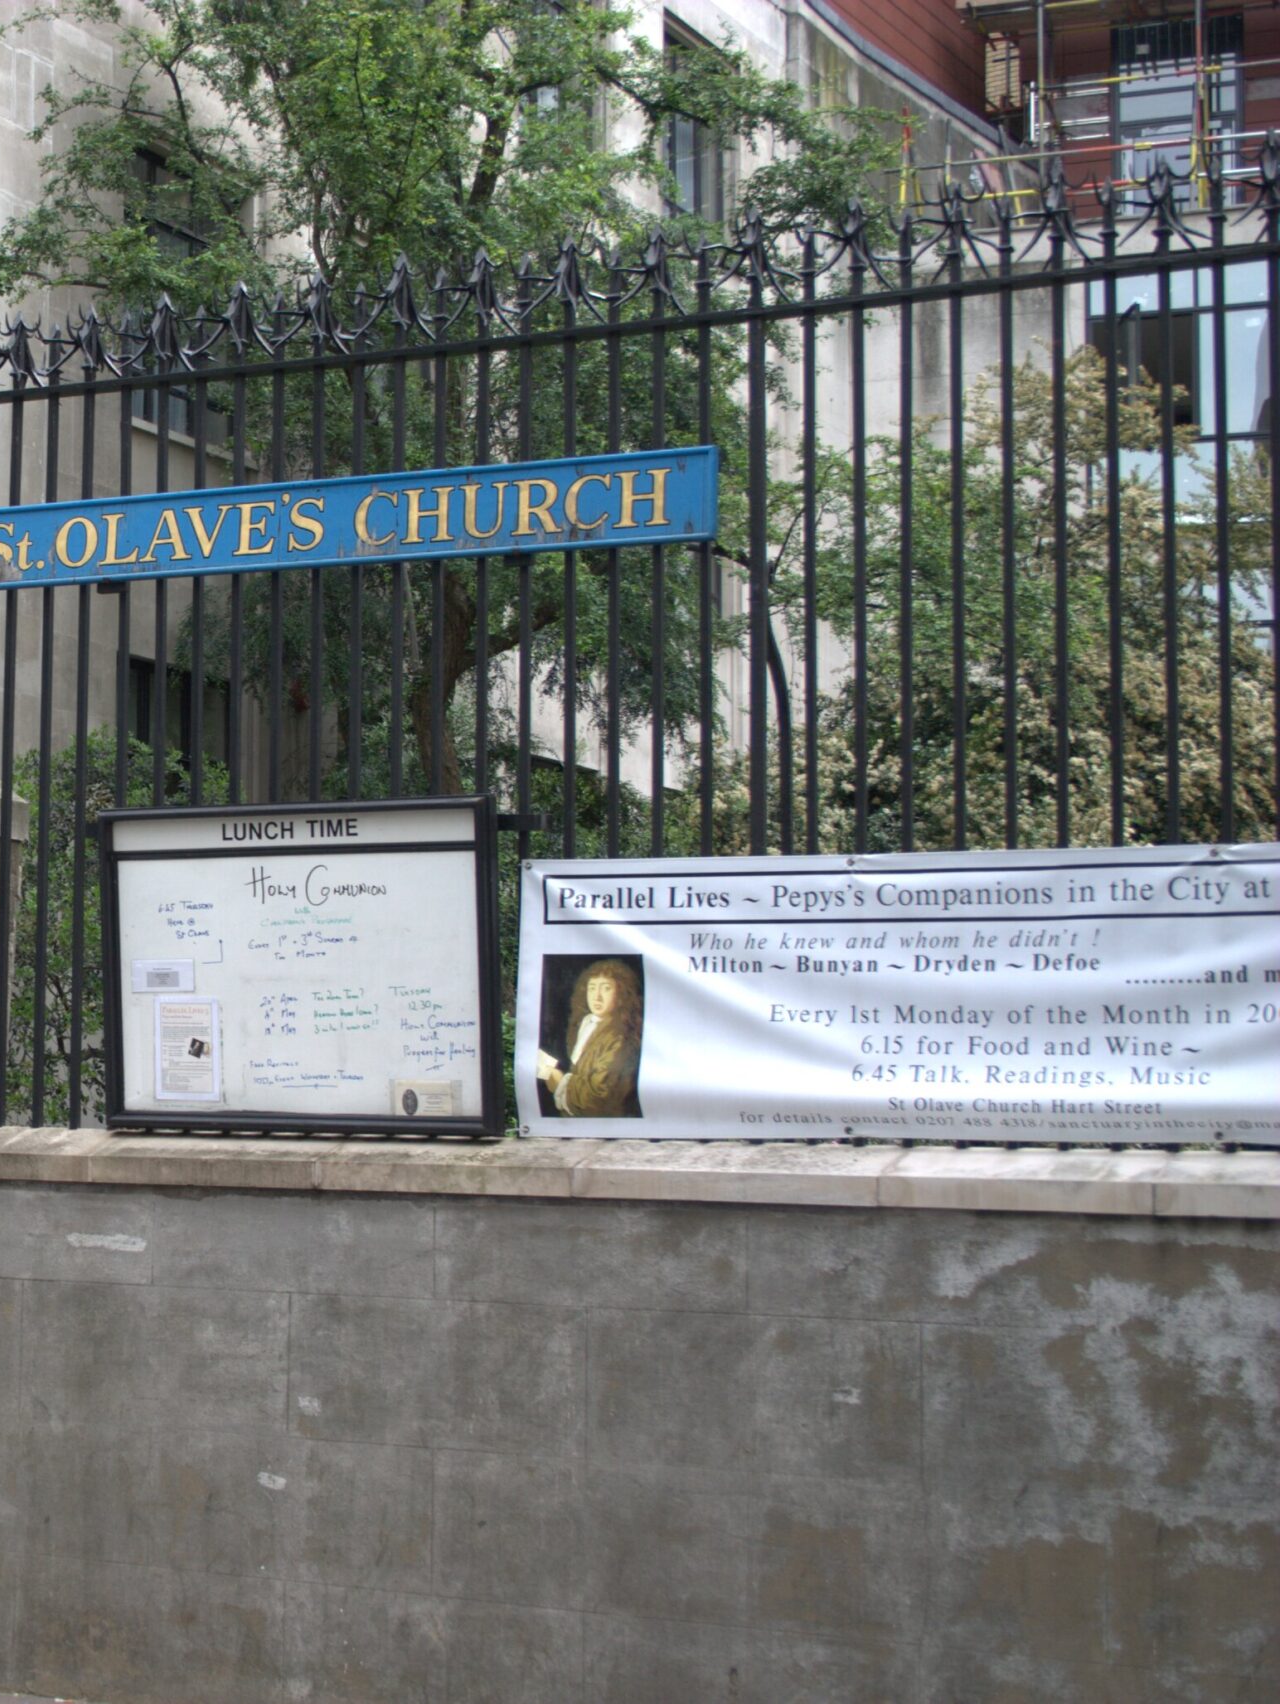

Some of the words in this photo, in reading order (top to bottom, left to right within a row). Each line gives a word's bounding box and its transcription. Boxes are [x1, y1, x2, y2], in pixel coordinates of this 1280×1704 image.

[54, 491, 325, 569] OLAVE'S
[354, 467, 672, 548] CHURCH
[222, 821, 294, 841] LUNCH
[306, 818, 359, 837] TIME
[558, 886, 655, 910] Parallel
[669, 886, 730, 908] Lives
[771, 884, 865, 912] Pepys's
[876, 881, 1053, 910] Companions
[1068, 879, 1095, 903] in
[1109, 878, 1154, 902] the
[1167, 876, 1230, 905] City
[1244, 877, 1271, 899] at
[689, 932, 734, 950] Who
[744, 932, 768, 950] he
[780, 932, 834, 950] knew
[846, 931, 888, 949] and
[900, 931, 959, 949] whom
[973, 930, 998, 948] he
[1009, 928, 1079, 949] didn't
[687, 956, 762, 973] Milton
[796, 955, 878, 976] Bunyan
[913, 954, 996, 975] Dryden
[1032, 953, 1101, 972] Defoe
[769, 1004, 837, 1027] Every
[850, 1004, 880, 1024] 1st
[894, 1004, 993, 1028] Monday
[1007, 1004, 1035, 1025] of
[1047, 1004, 1087, 1025] the
[1102, 1004, 1190, 1025] Month
[1205, 1003, 1231, 1024] in
[1247, 1003, 1280, 1024] 20
[861, 1036, 904, 1055] 6.15
[917, 1036, 953, 1055] for
[968, 1036, 1029, 1056] Food
[1044, 1036, 1091, 1056] and
[1105, 1035, 1172, 1056] Wine
[852, 1064, 897, 1083] 6.45
[1130, 1066, 1211, 1086] Music
[888, 1097, 905, 1112] St
[914, 1097, 964, 1112] Olave
[972, 1098, 1041, 1114] Church
[1051, 1099, 1094, 1114] Hart
[1104, 1099, 1162, 1115] Street
[740, 1111, 765, 1124] for
[773, 1112, 833, 1124] details
[841, 1113, 908, 1125] contact
[916, 1115, 954, 1127] 0207
[963, 1117, 993, 1128] 488
